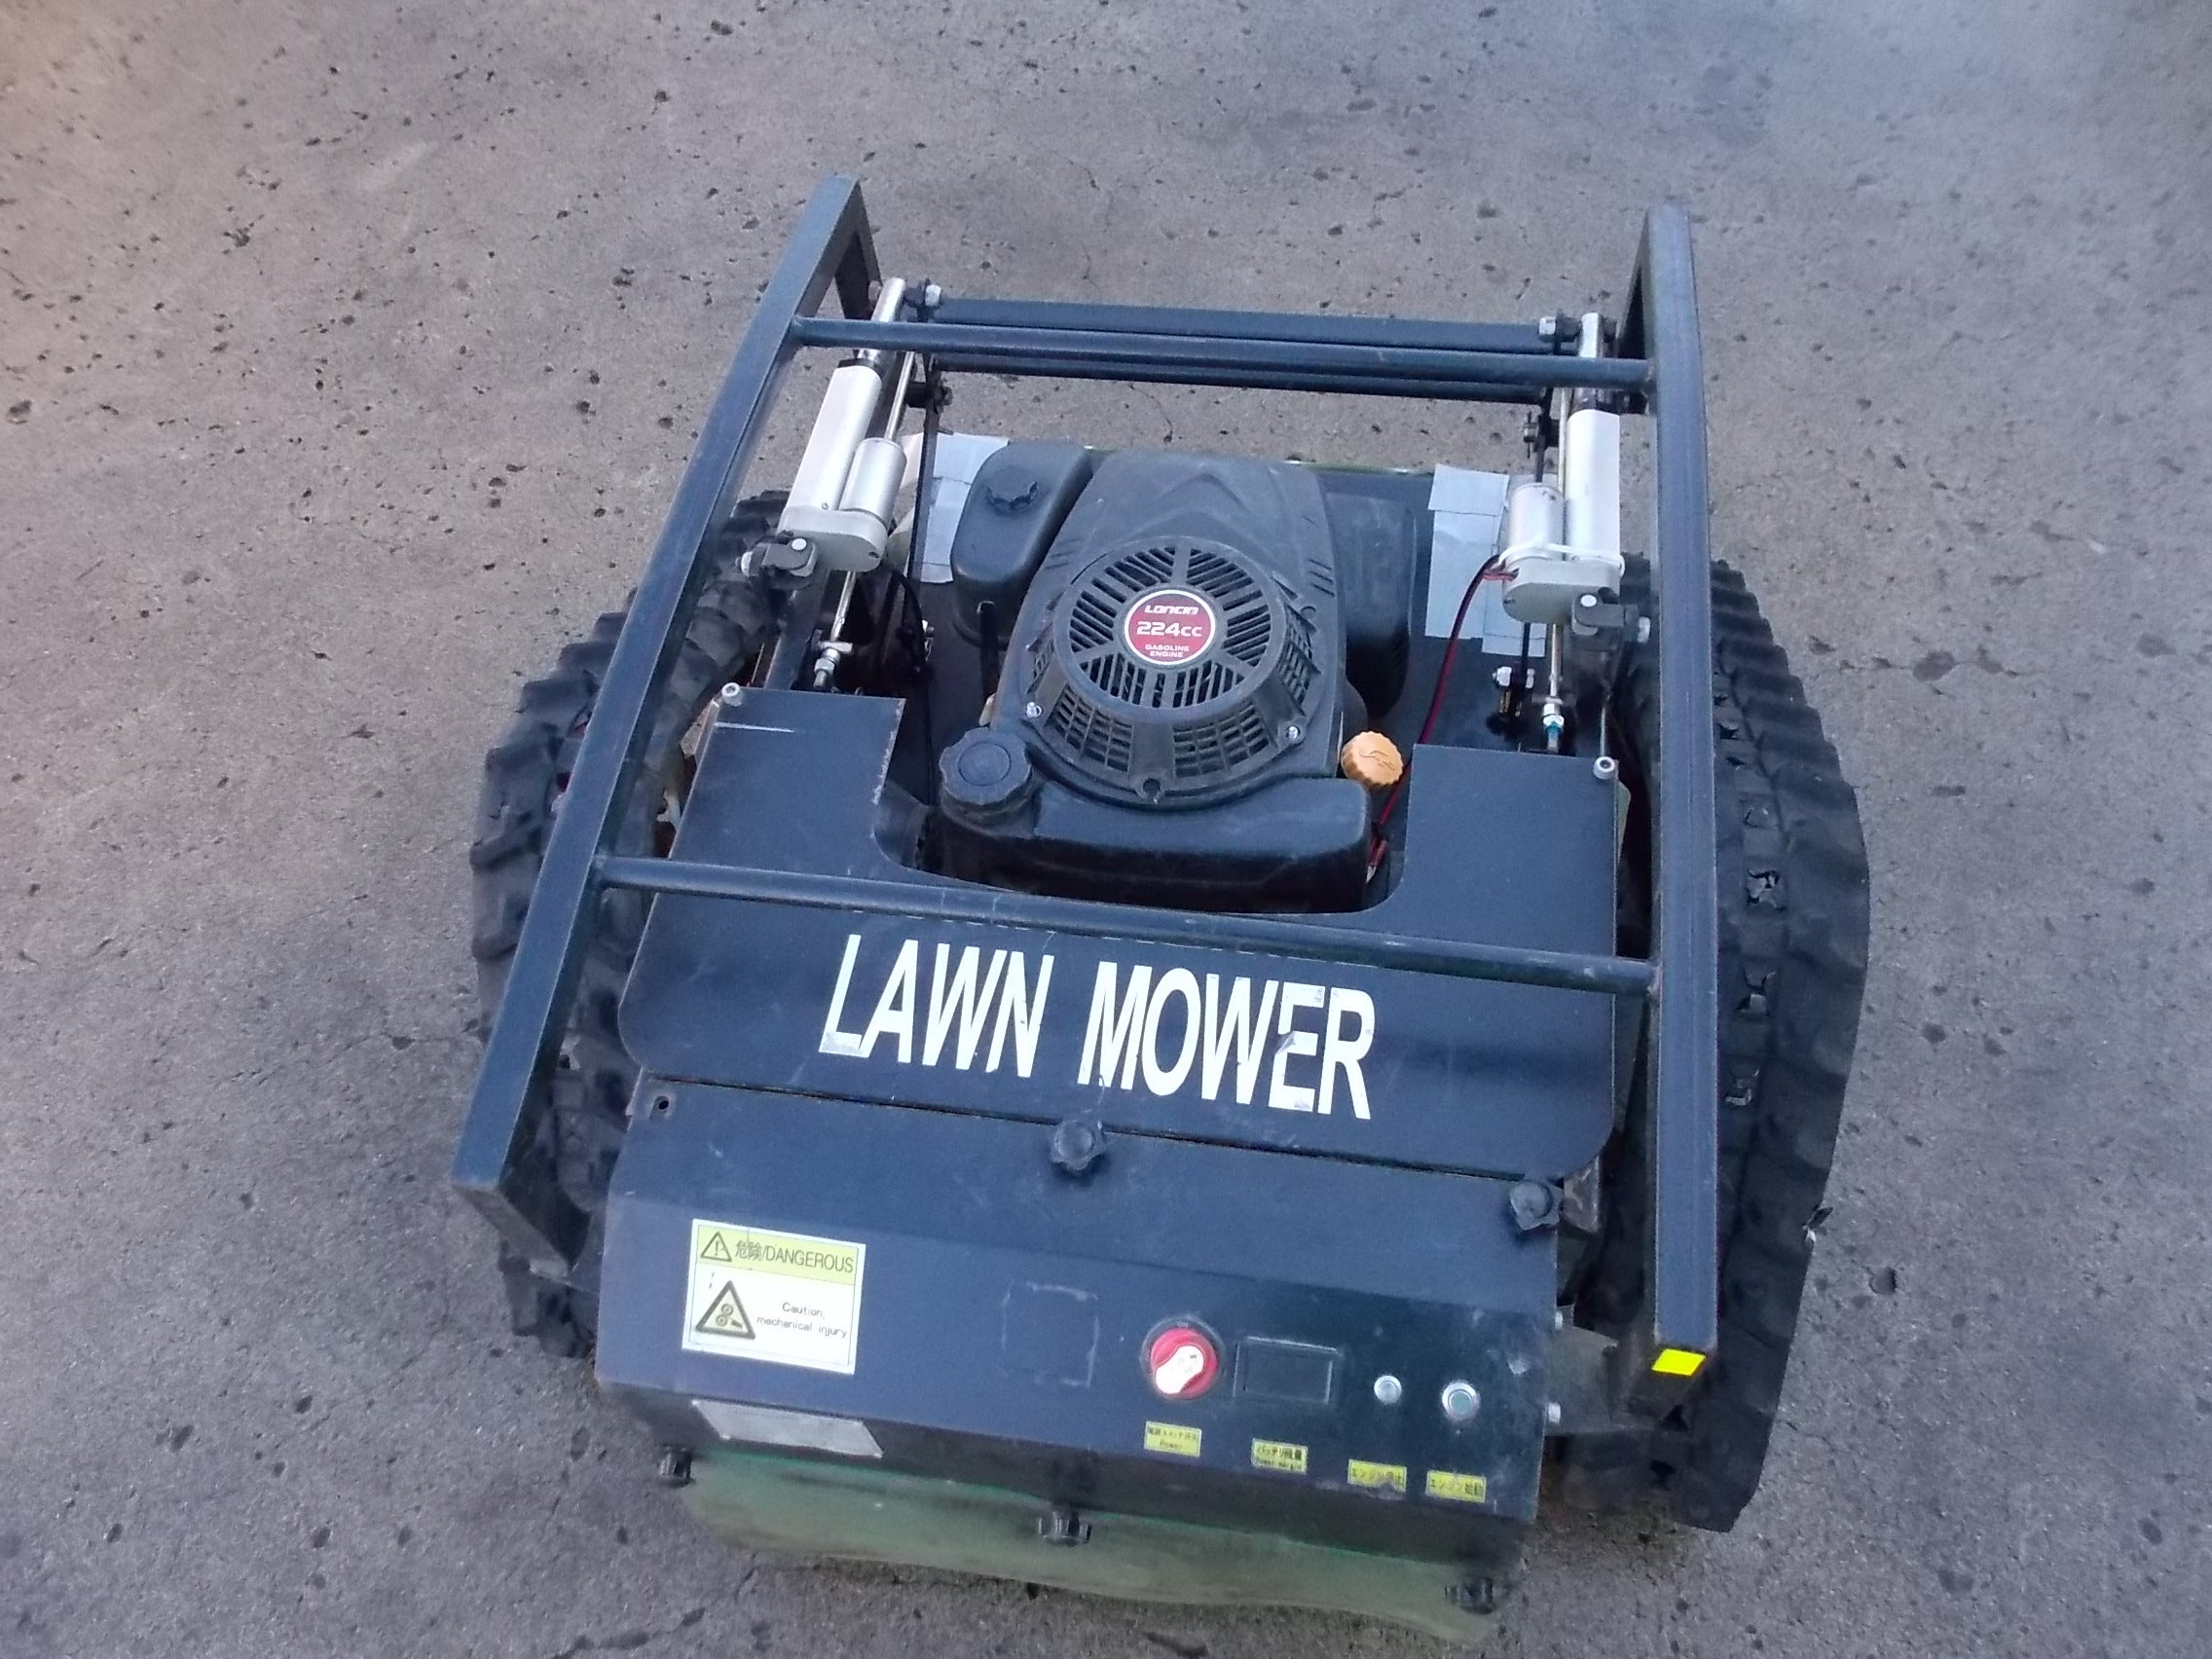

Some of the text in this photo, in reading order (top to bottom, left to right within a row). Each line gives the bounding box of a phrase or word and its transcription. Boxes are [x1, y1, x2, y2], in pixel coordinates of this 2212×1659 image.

[819, 934, 1377, 1121] LAWN MOWER
[756, 1314, 847, 1339] mechanical injury
